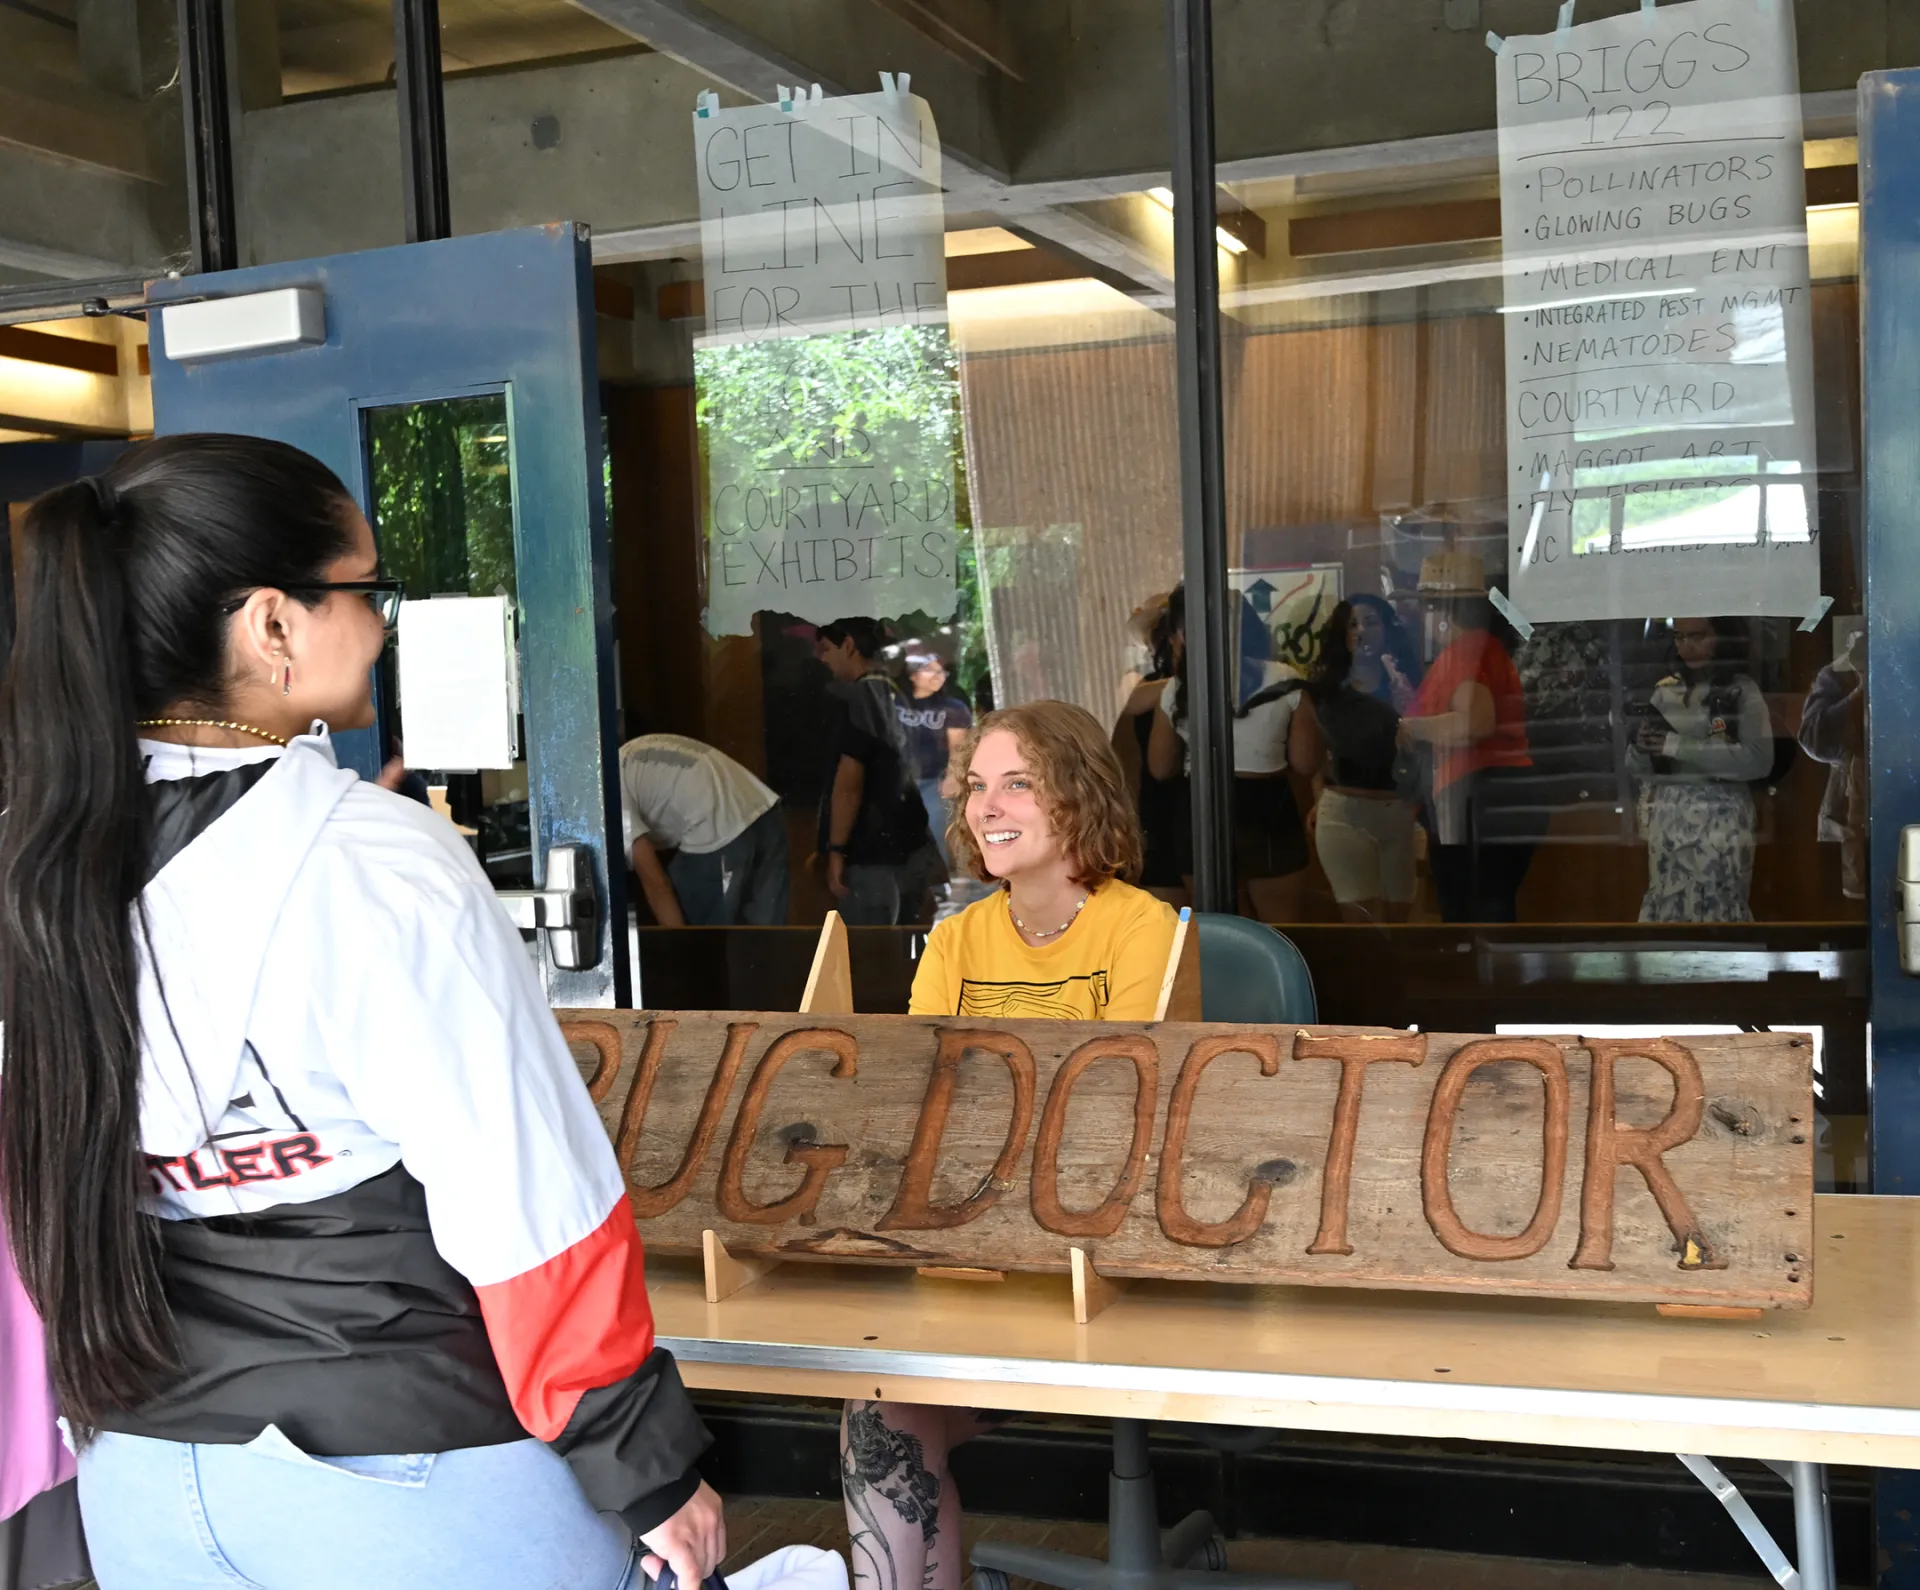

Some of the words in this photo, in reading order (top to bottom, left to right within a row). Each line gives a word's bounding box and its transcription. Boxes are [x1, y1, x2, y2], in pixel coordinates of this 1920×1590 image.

[1513, 23, 1750, 105] BRIGGS
[1581, 100, 1685, 145] 122
[705, 119, 808, 192] GET
[837, 114, 923, 179] IN
[1538, 154, 1775, 203] POLLINATORS
[720, 181, 914, 274] LINE
[1535, 206, 1643, 241] GLOWING
[1668, 195, 1752, 226] BUGS
[1540, 254, 1684, 291] MEDICAL
[1711, 243, 1787, 275] ENT
[713, 285, 813, 345] FOR
[829, 281, 937, 340] THE
[1534, 301, 1646, 329] INTEGRATED
[1658, 296, 1705, 319] PEST
[1533, 323, 1737, 366] NEMATODES
[1517, 381, 1735, 429] COURTYARD
[713, 479, 950, 537] COURTYARD
[1528, 489, 1579, 516] FLY
[146, 1132, 334, 1195] TLER
[874, 1025, 1728, 1272] DOCTOR
